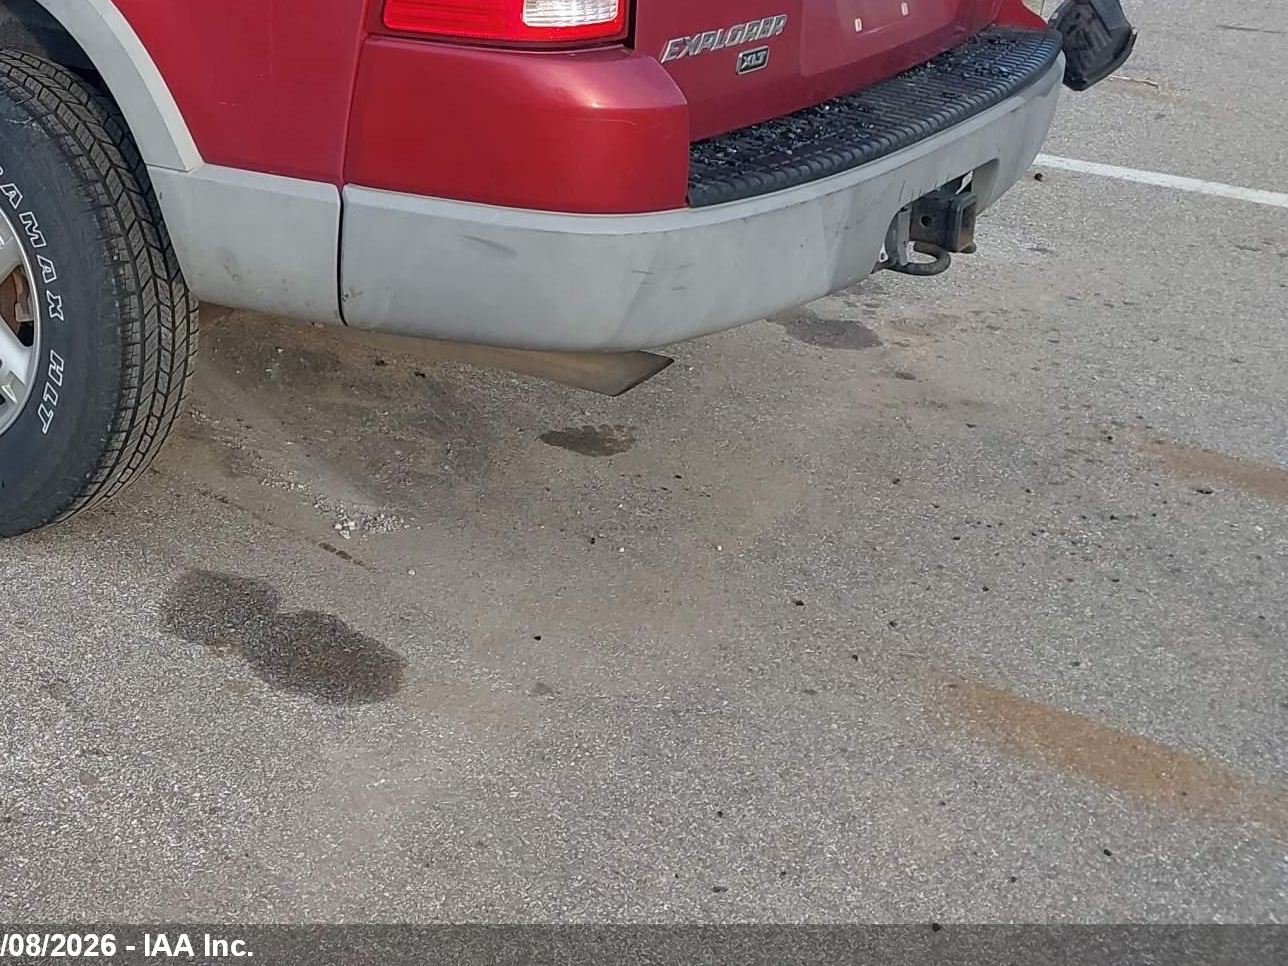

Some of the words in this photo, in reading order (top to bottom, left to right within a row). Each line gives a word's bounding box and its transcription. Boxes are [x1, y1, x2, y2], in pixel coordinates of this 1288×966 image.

[660, 13, 788, 64] EXPLORER
[740, 50, 766, 70] XLT
[37, 349, 65, 434] HLT
